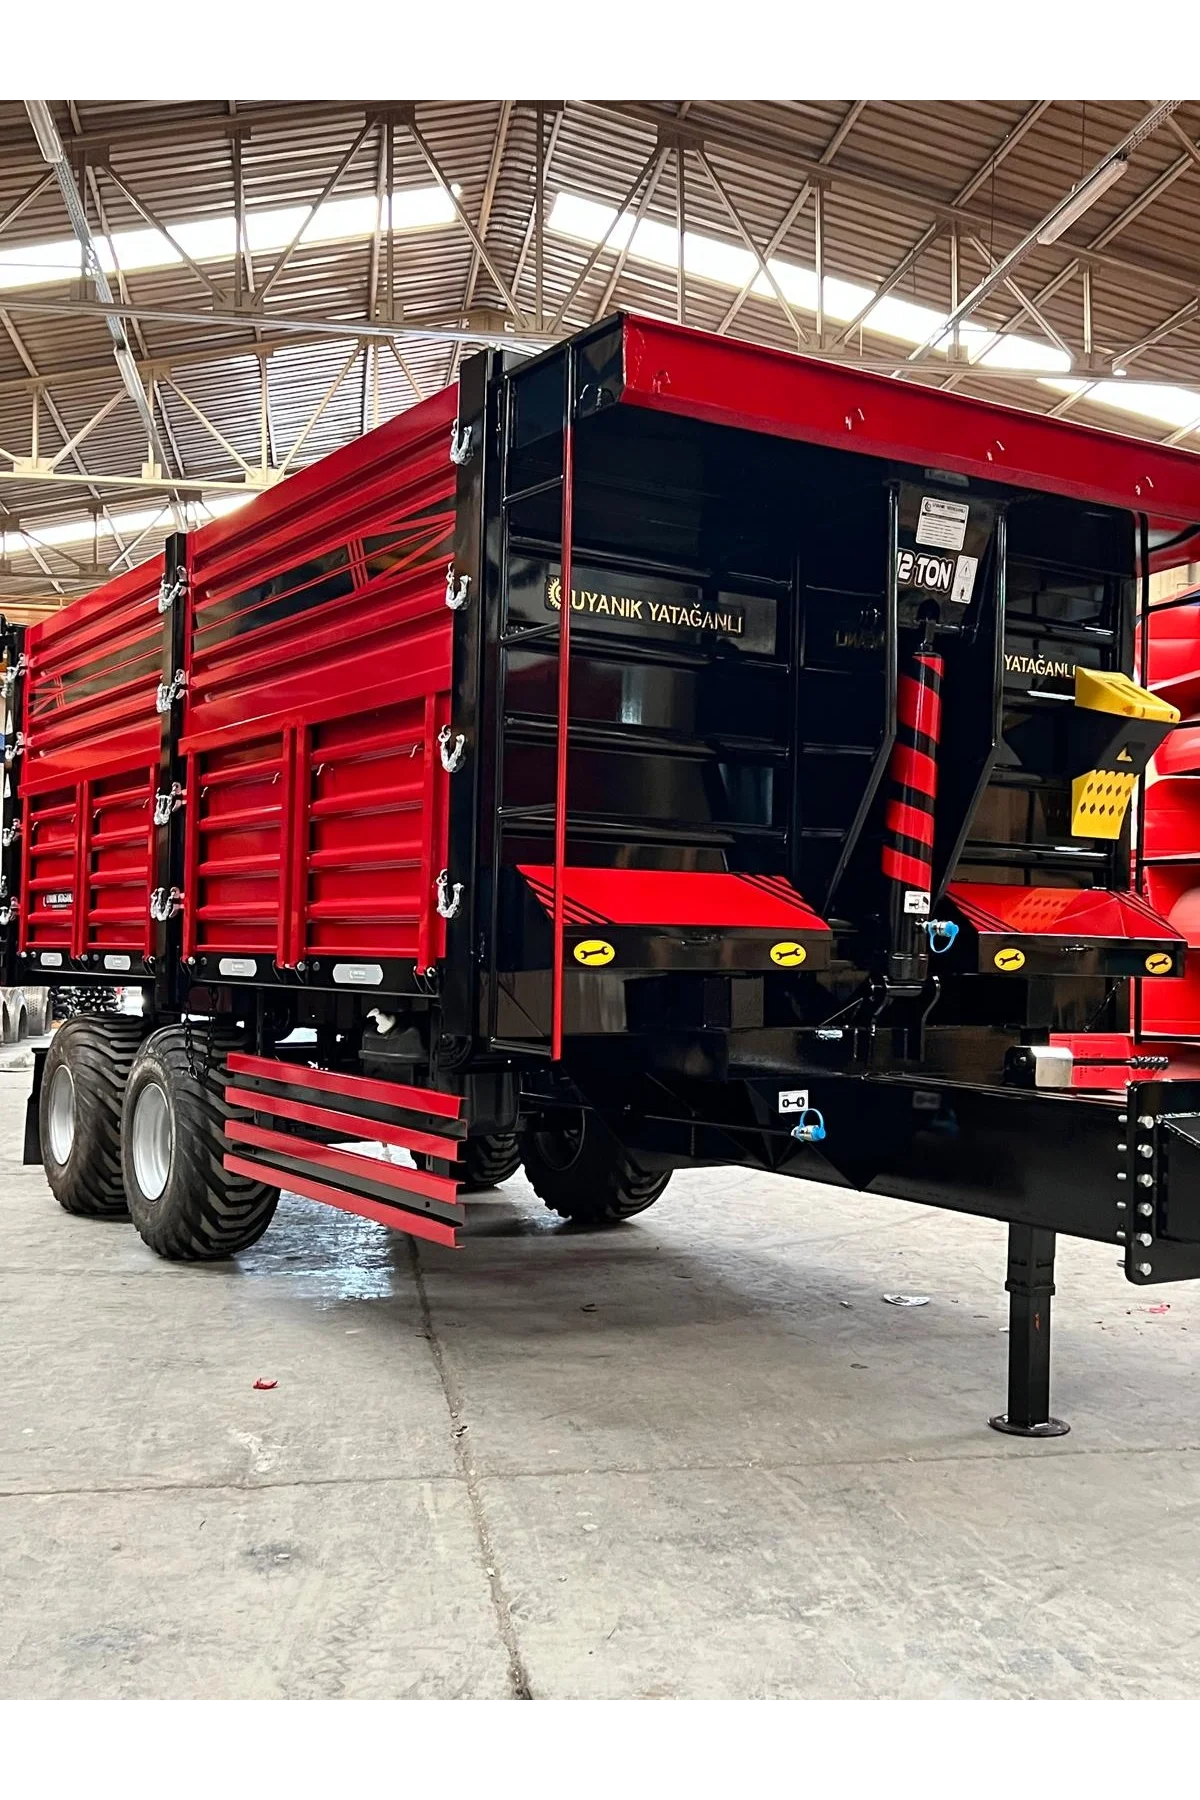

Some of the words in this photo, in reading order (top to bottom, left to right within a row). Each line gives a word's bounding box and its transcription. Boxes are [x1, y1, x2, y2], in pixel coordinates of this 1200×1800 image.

[917, 556, 952, 589] TON
[571, 589, 643, 619] UYANIK
[648, 601, 742, 634] YATAĞANLI
[1004, 653, 1076, 679] YATAĞANLI
